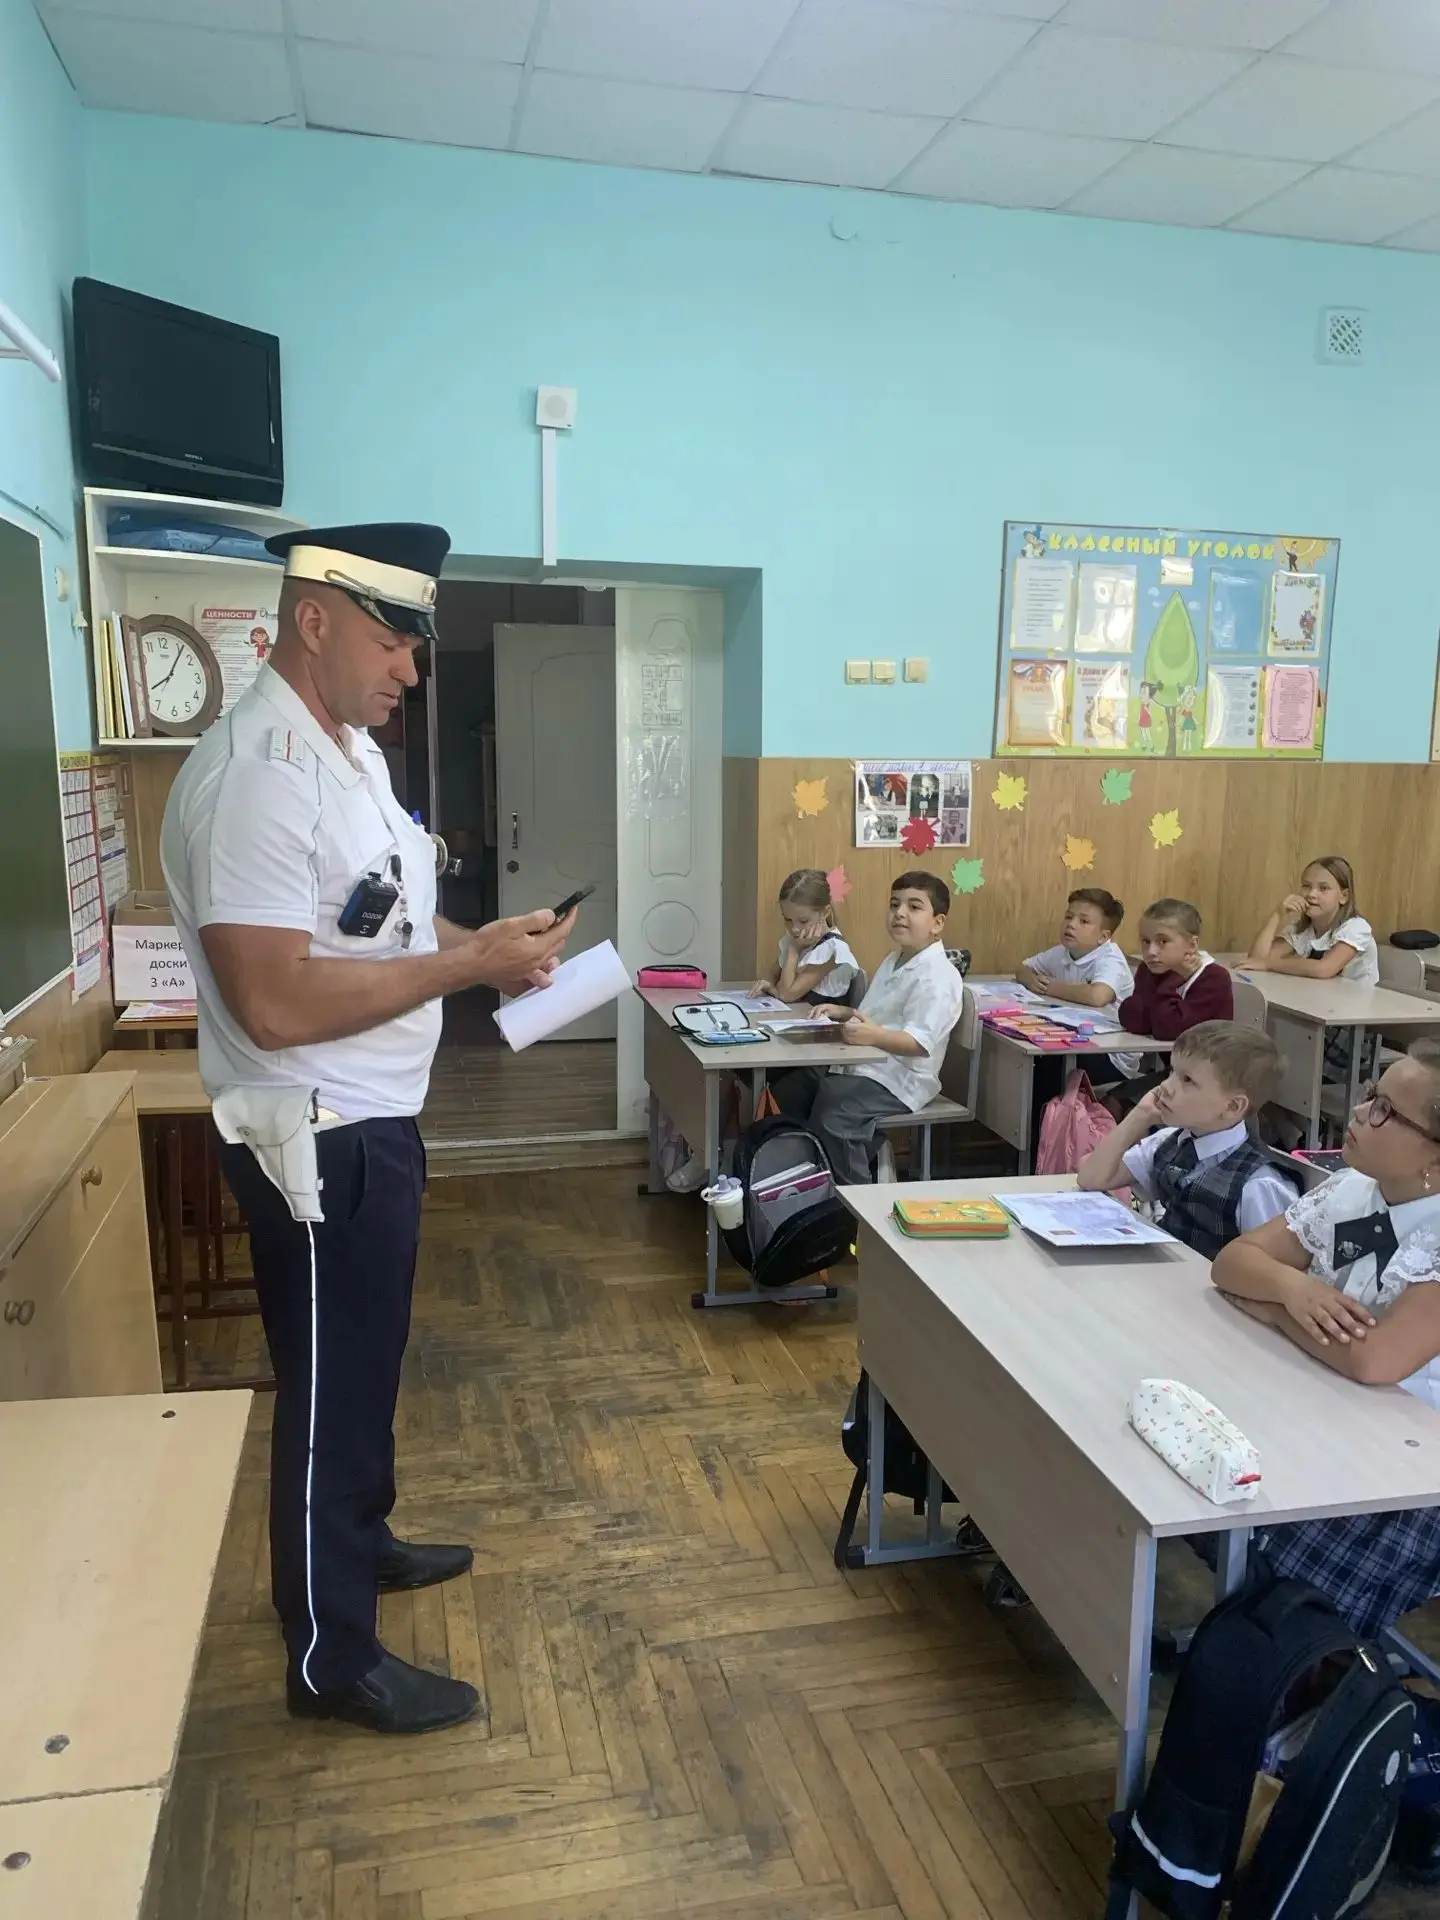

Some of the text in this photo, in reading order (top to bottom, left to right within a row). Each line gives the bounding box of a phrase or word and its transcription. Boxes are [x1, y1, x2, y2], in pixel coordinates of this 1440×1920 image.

[1048, 532, 1277, 561] КЛАССНЫЙ УГОЛОК
[206, 609, 253, 619] ЦЕННОСТИ
[146, 641, 154, 653] 11
[157, 637, 169, 650] 12
[186, 654, 194, 666] 2
[194, 672, 202, 685] 3
[193, 690, 199, 701] 4
[155, 700, 162, 712] 7
[171, 705, 178, 717] 6
[184, 701, 191, 713] 5
[149, 960, 188, 971] доски
[150, 977, 186, 988] 3 «А»
